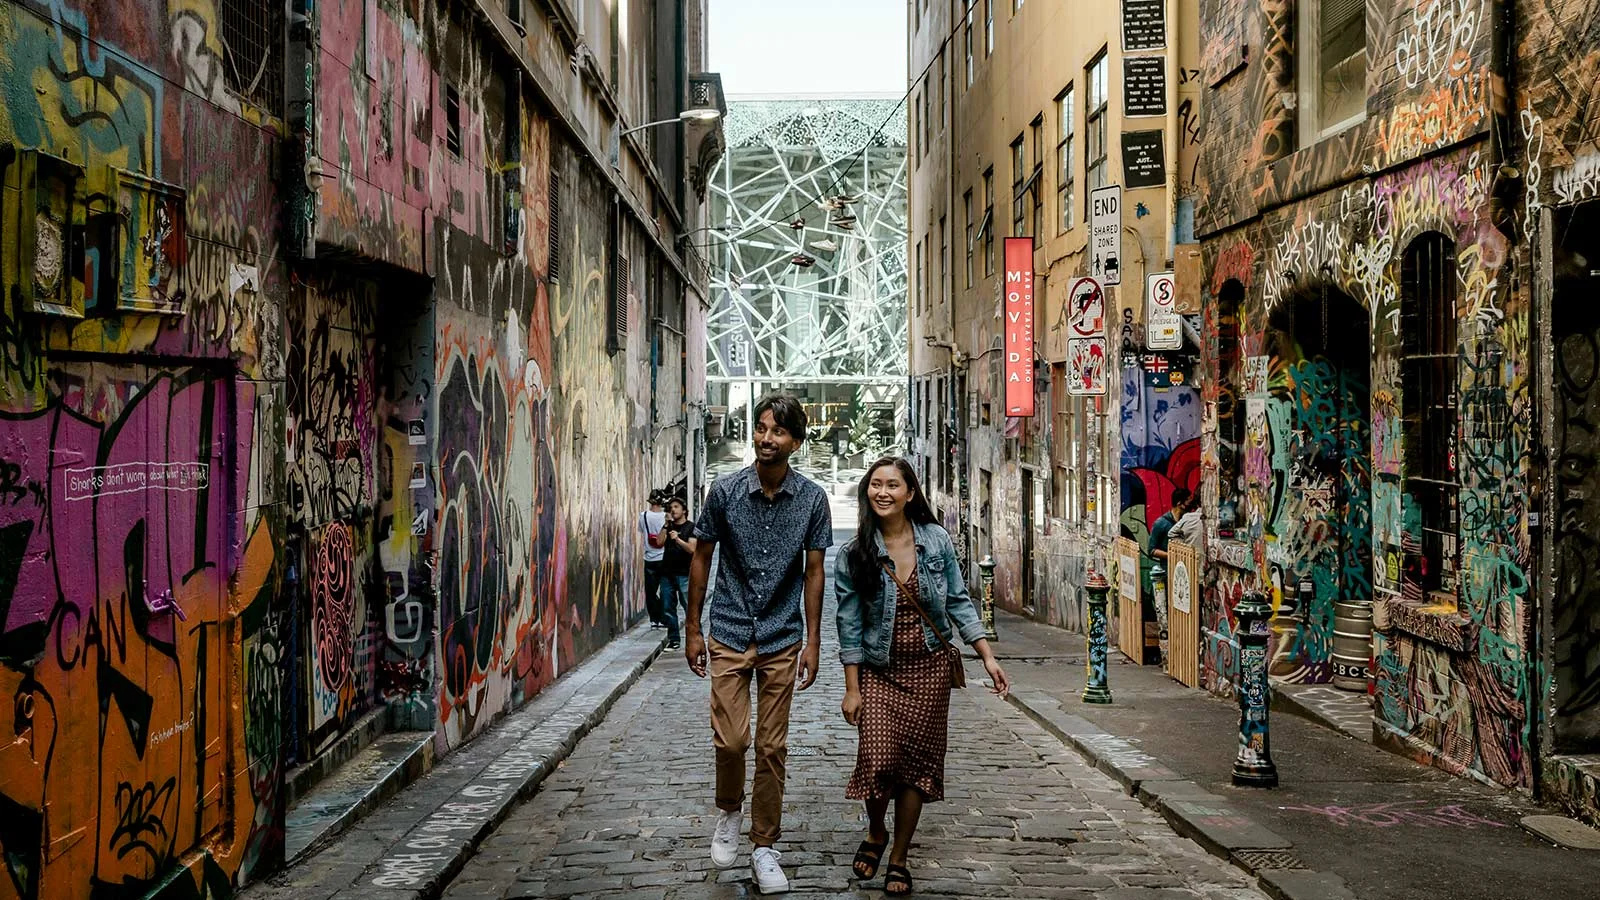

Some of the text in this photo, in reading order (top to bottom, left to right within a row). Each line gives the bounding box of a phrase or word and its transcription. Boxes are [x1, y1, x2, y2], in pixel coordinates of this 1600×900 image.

[1094, 196, 1117, 216] END
[1093, 224, 1118, 236] SHARED
[1097, 236, 1114, 247] ZONE
[1007, 271, 1020, 382] MOVIDA
[70, 473, 104, 491] Sharks
[126, 471, 147, 486] worry
